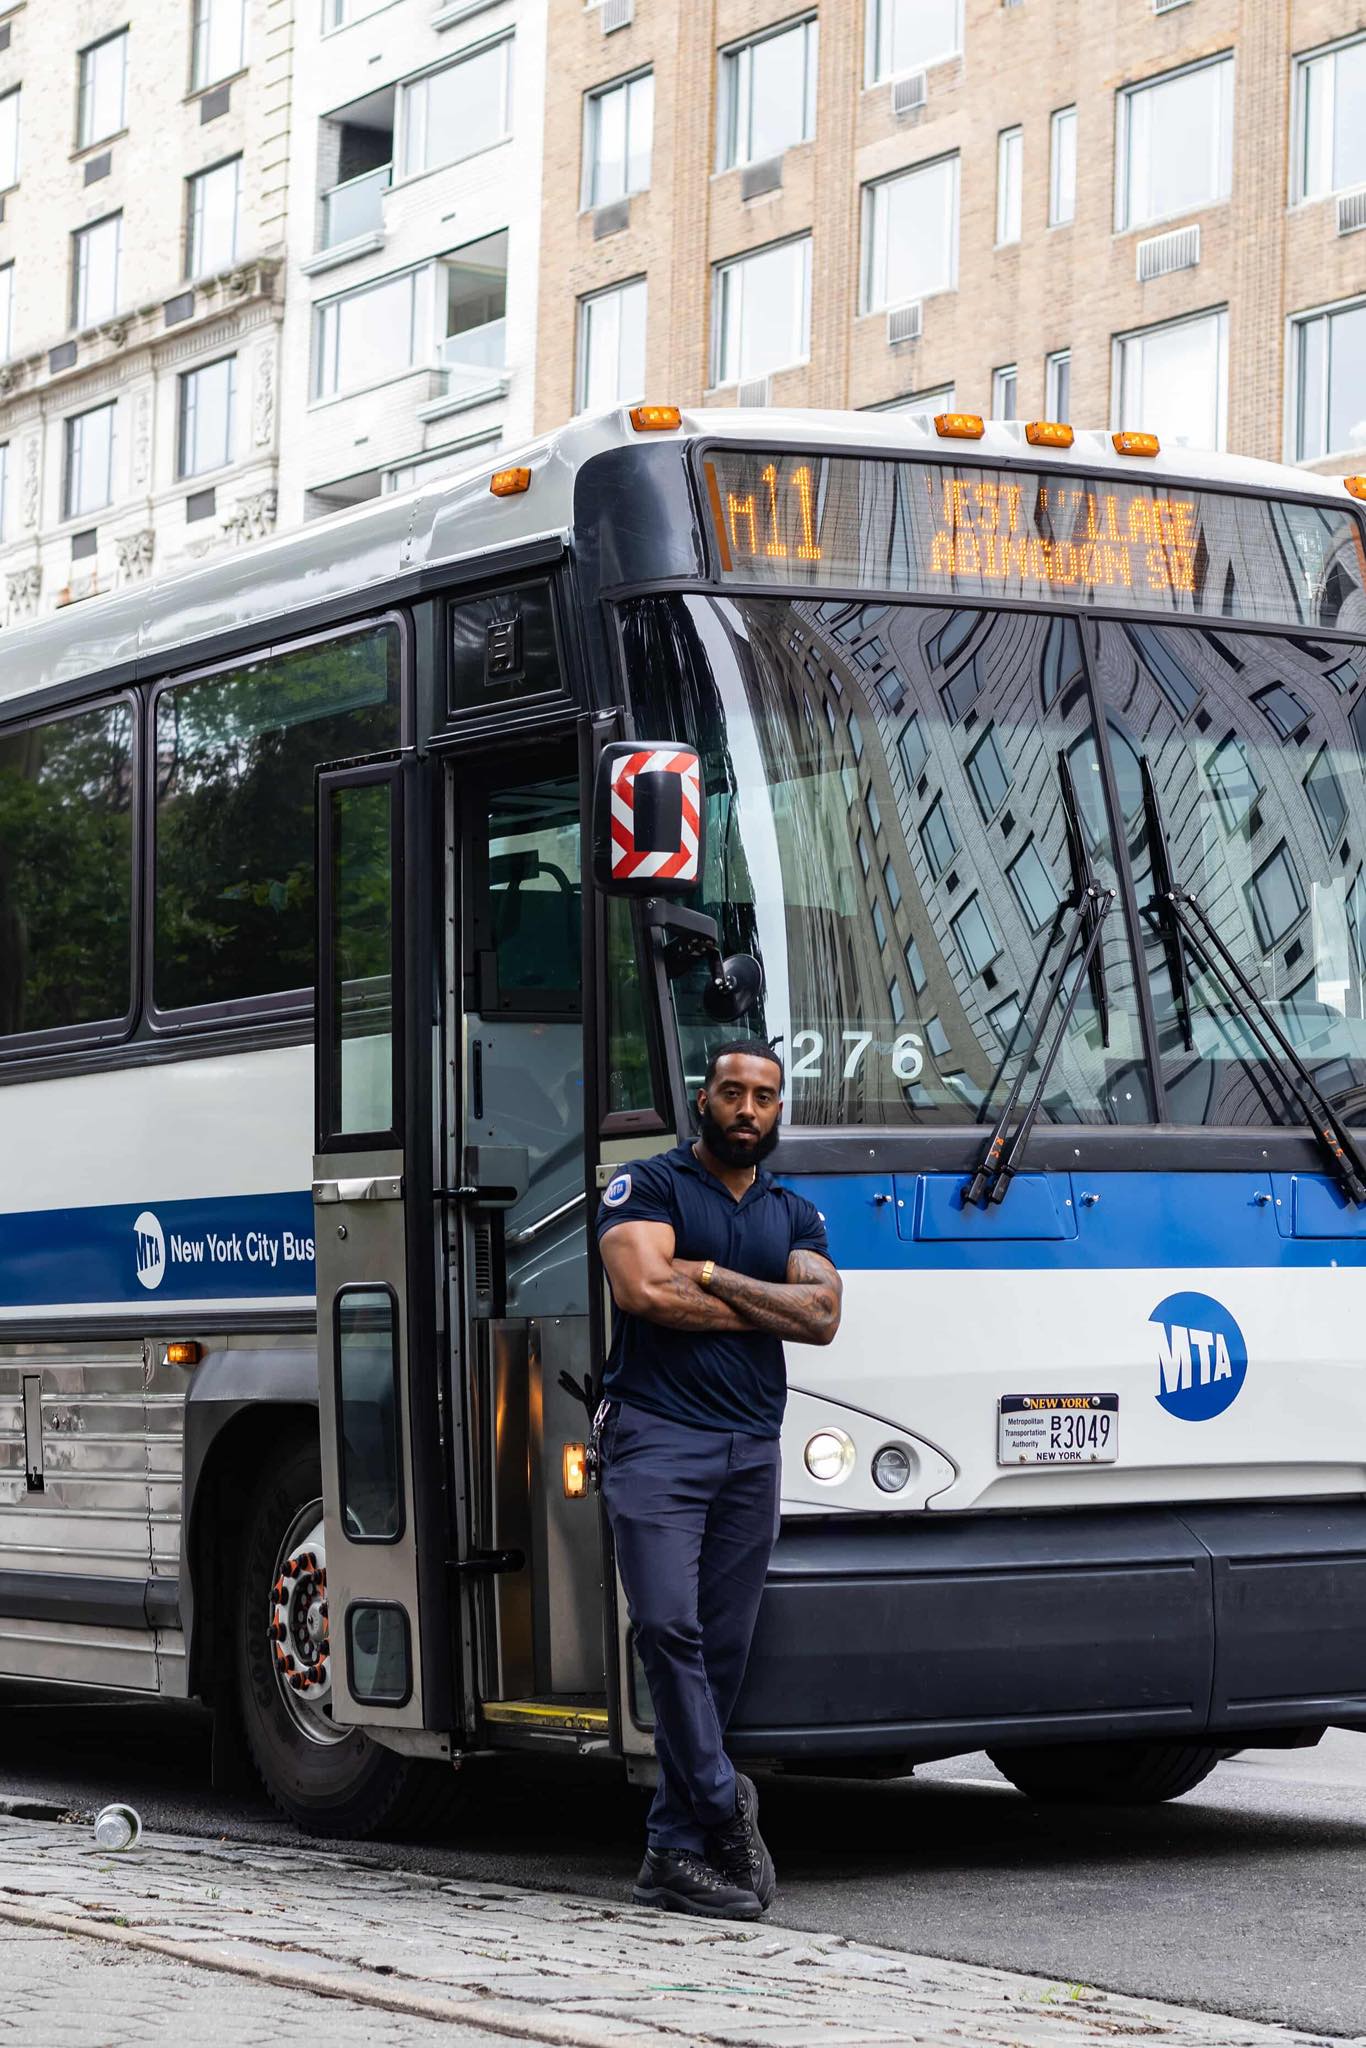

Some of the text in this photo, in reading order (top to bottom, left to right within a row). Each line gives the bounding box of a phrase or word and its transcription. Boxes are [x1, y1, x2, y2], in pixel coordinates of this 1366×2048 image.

[170, 1231, 315, 1268] New York City Bus
[1150, 1319, 1233, 1397] MTA
[1030, 1397, 1091, 1409] NEW YORK
[1008, 1418, 1044, 1426] Metropolitan
[1005, 1429, 1047, 1437] Transportation
[1064, 1414, 1111, 1449] 3049
[1012, 1440, 1039, 1448] Authority
[1036, 1451, 1082, 1461] NEW YORK
